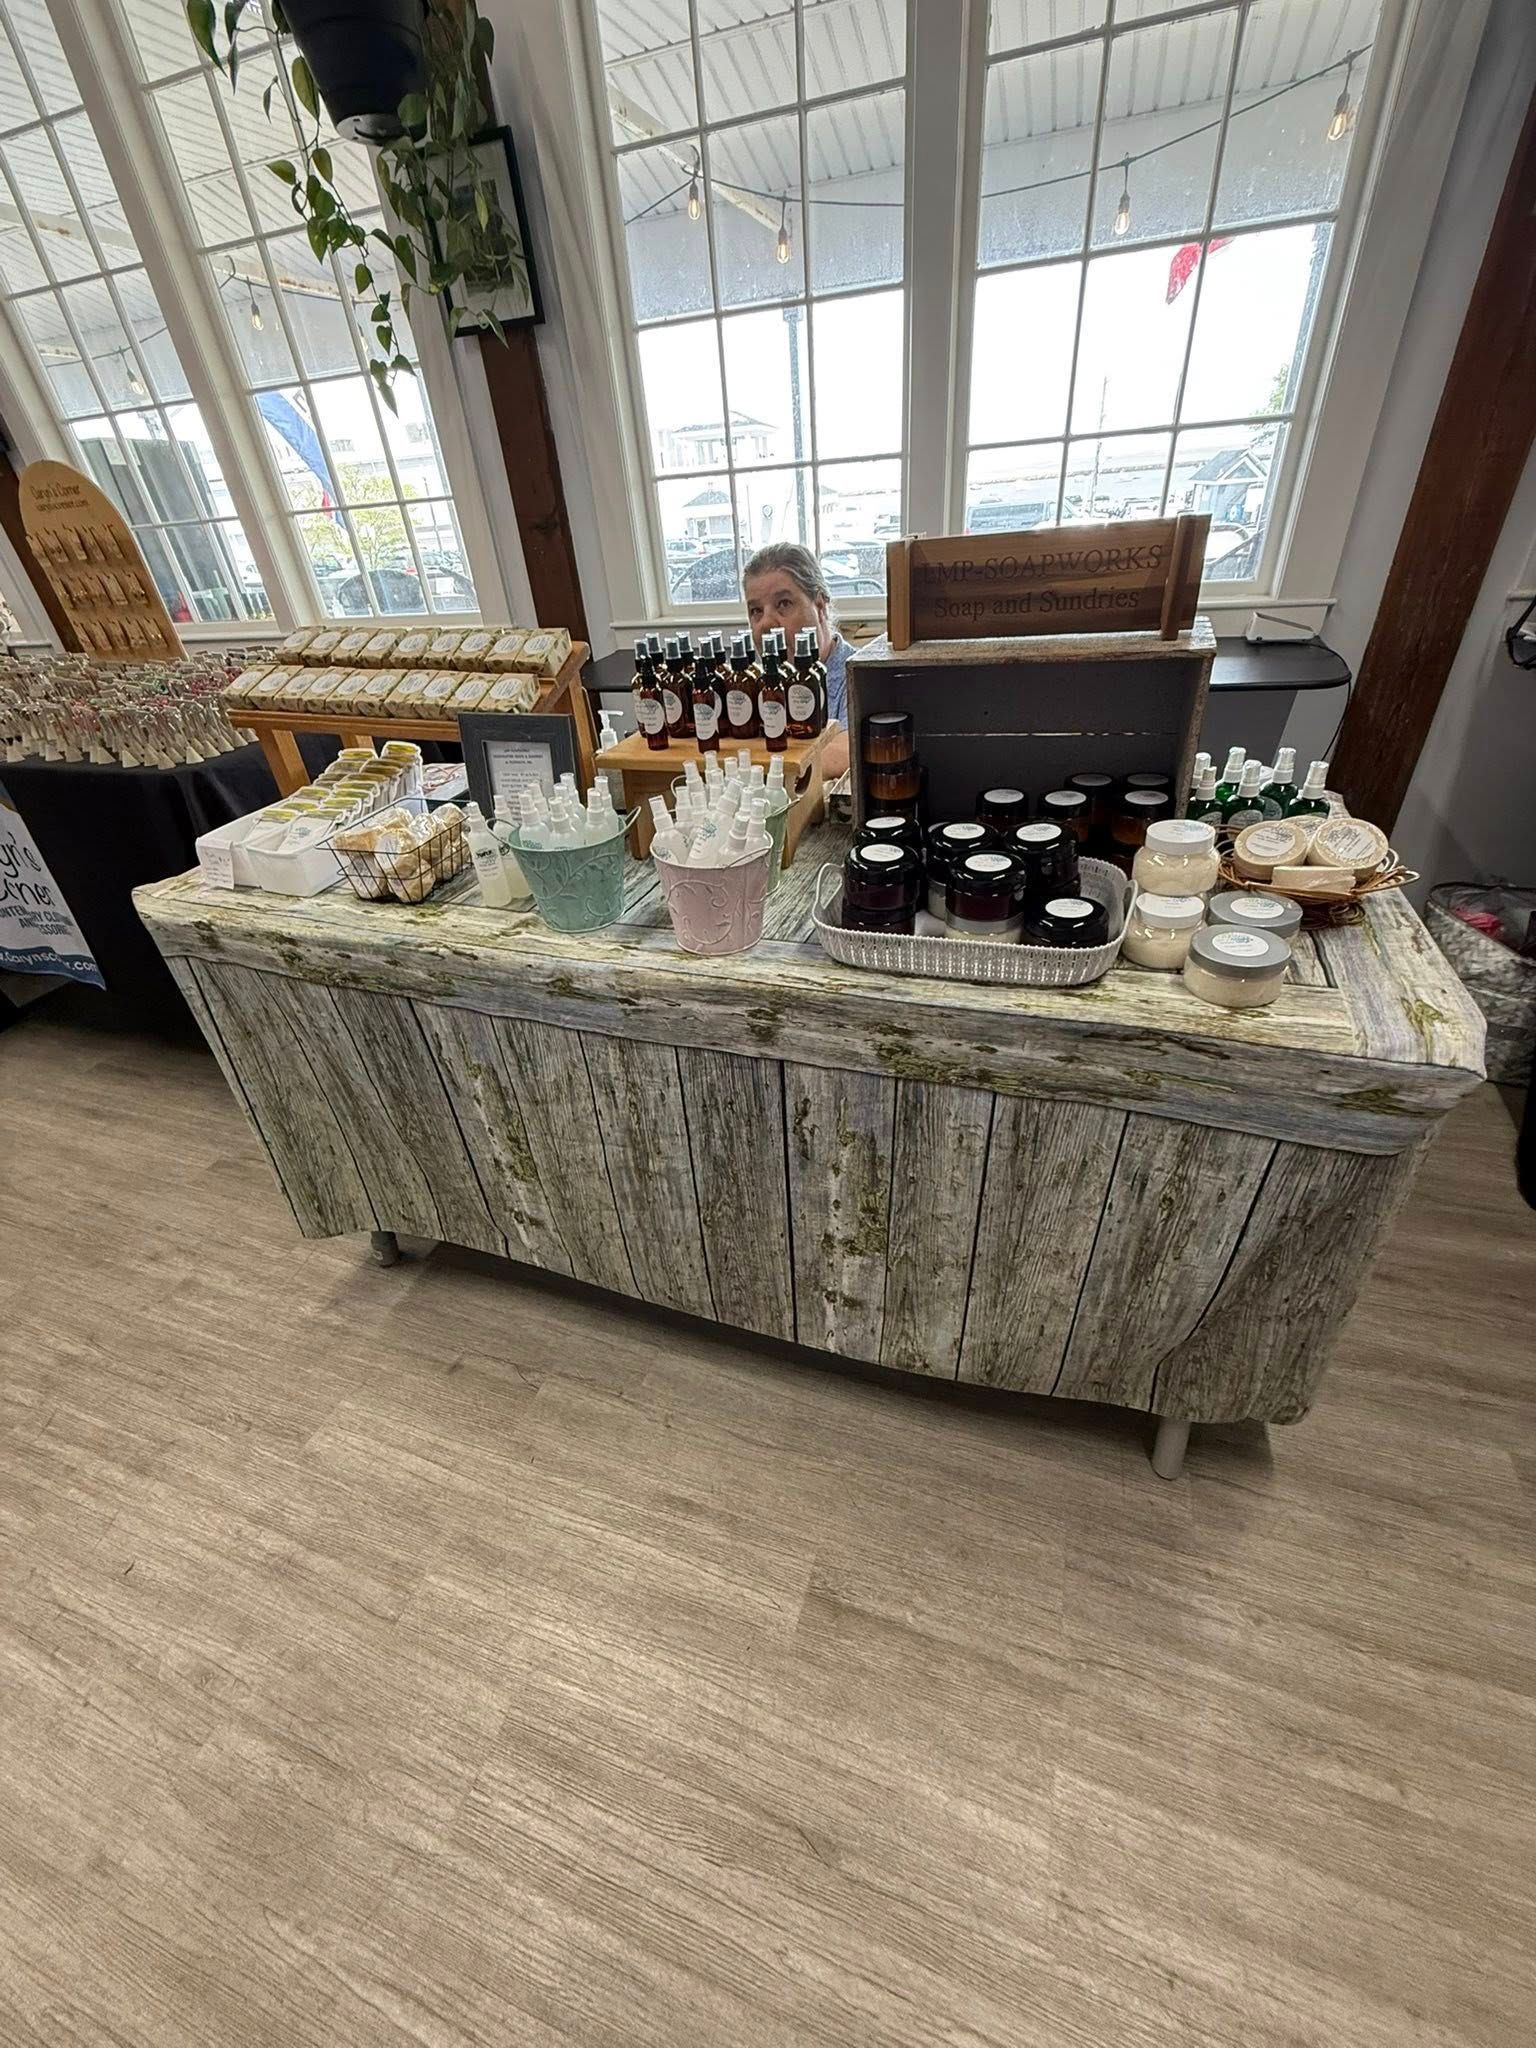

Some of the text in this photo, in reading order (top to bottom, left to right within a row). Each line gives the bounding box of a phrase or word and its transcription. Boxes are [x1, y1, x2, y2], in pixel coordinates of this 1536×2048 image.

[934, 586, 1139, 623] Soap and Sundries
